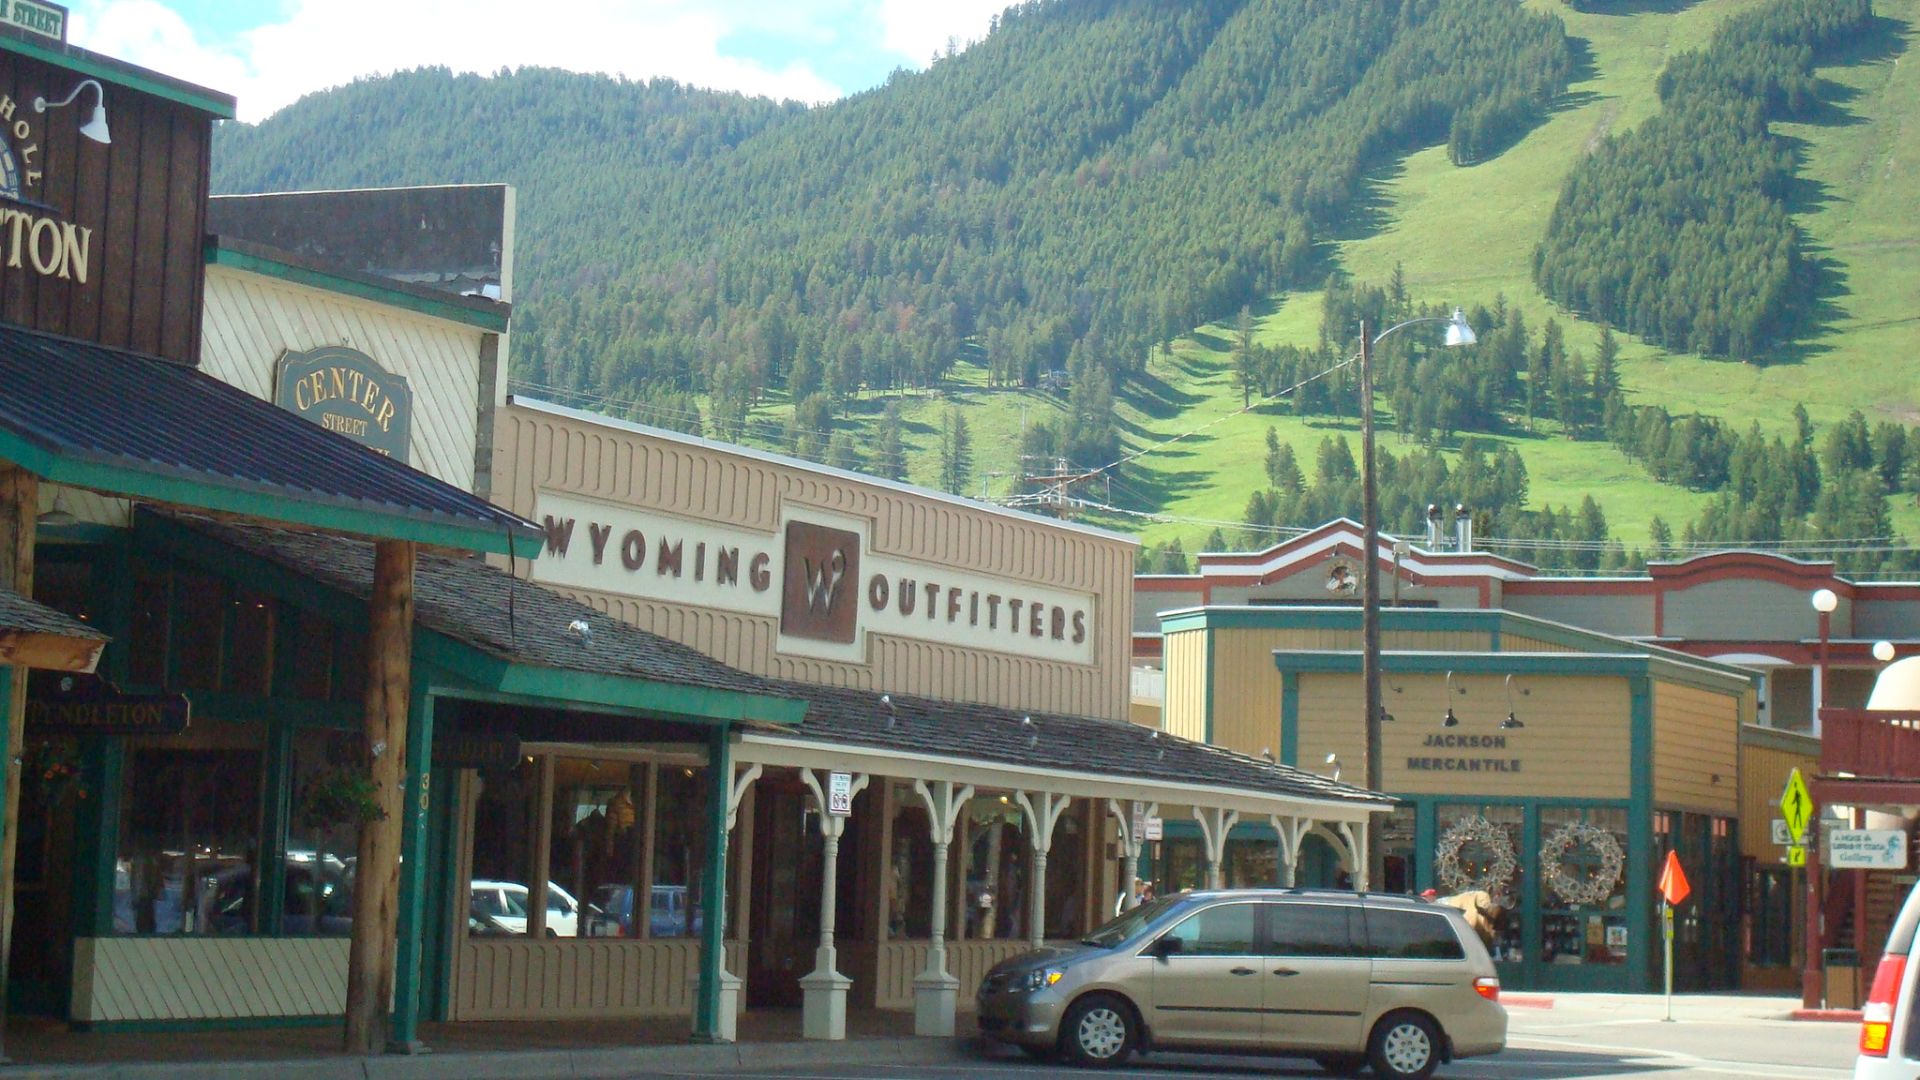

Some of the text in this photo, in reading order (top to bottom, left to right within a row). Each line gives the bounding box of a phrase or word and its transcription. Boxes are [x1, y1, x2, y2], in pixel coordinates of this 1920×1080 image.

[13, 1, 61, 36] STREET
[0, 207, 92, 284] TON
[295, 366, 395, 433] CENTER
[321, 411, 368, 437] STREET
[543, 514, 771, 592] WYOMING
[868, 573, 1086, 644] OUTFITTERS
[1407, 756, 1521, 773] MERCANTILE
[1423, 734, 1506, 749] JACKSON
